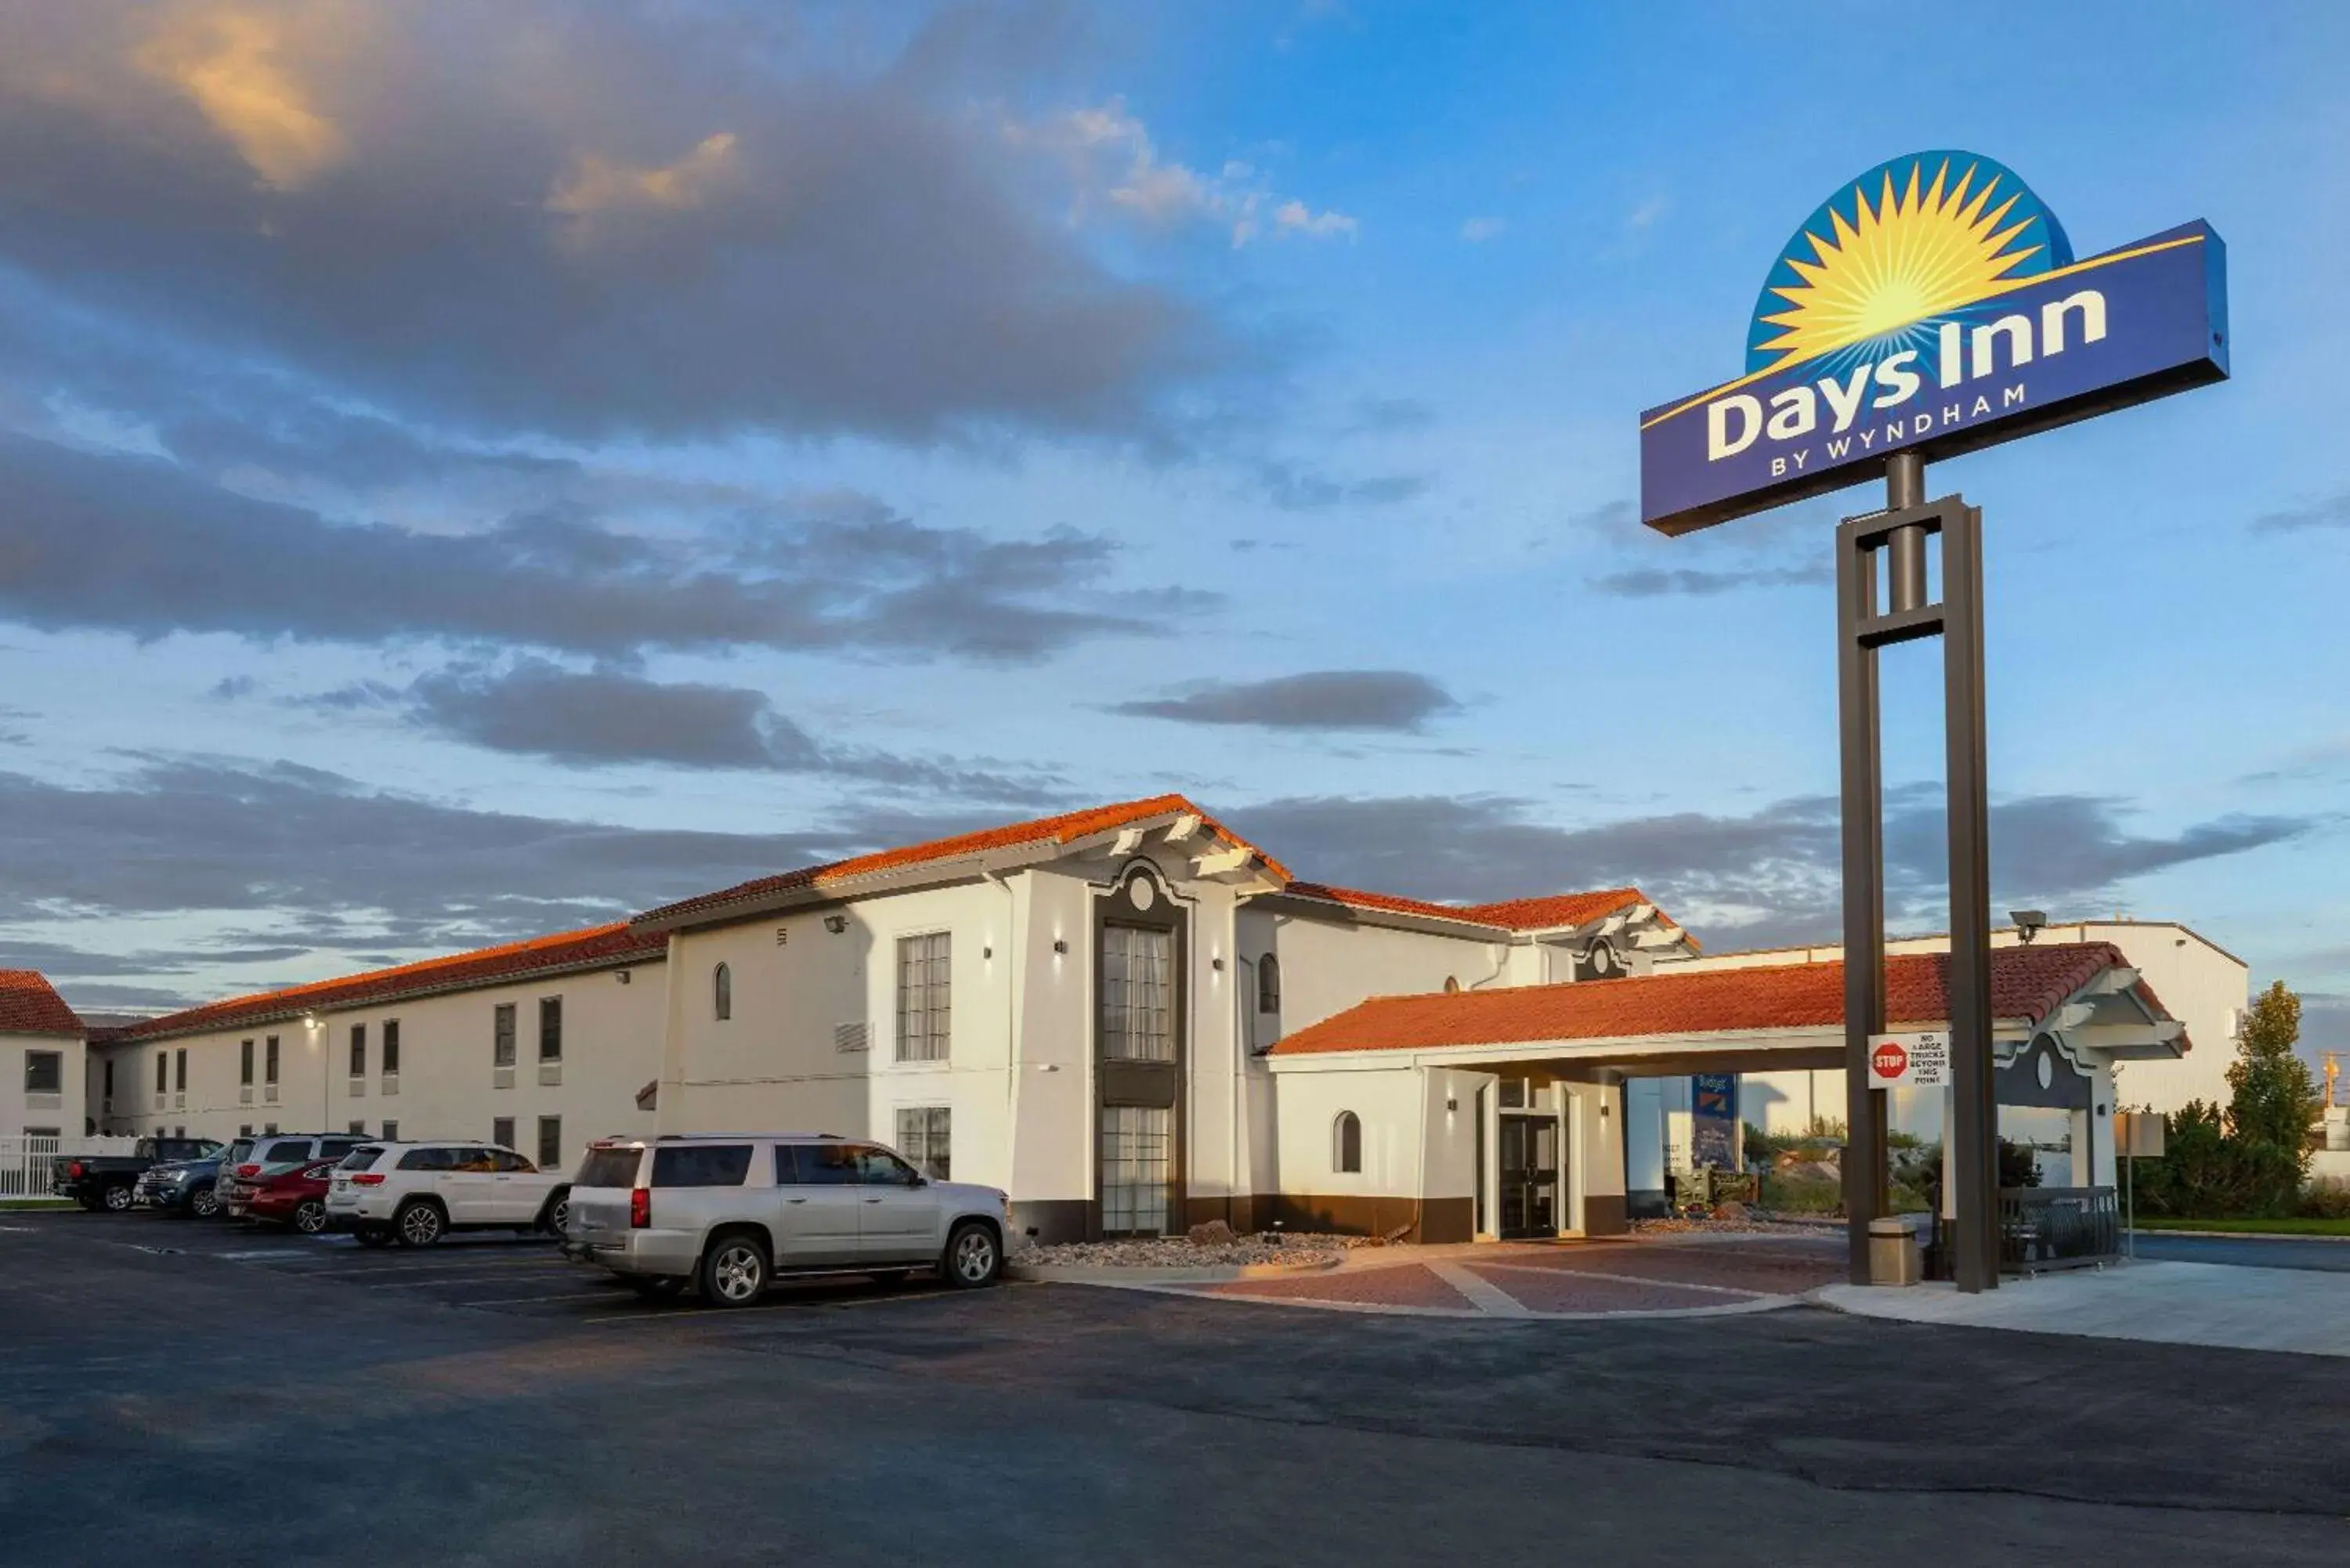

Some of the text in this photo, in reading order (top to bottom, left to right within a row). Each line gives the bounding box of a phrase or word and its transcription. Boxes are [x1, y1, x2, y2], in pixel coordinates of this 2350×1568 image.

[1708, 291, 2106, 461] Days Inn
[1772, 384, 2024, 476] BY WYNDHAM
[1875, 1055, 1904, 1068] STOP
